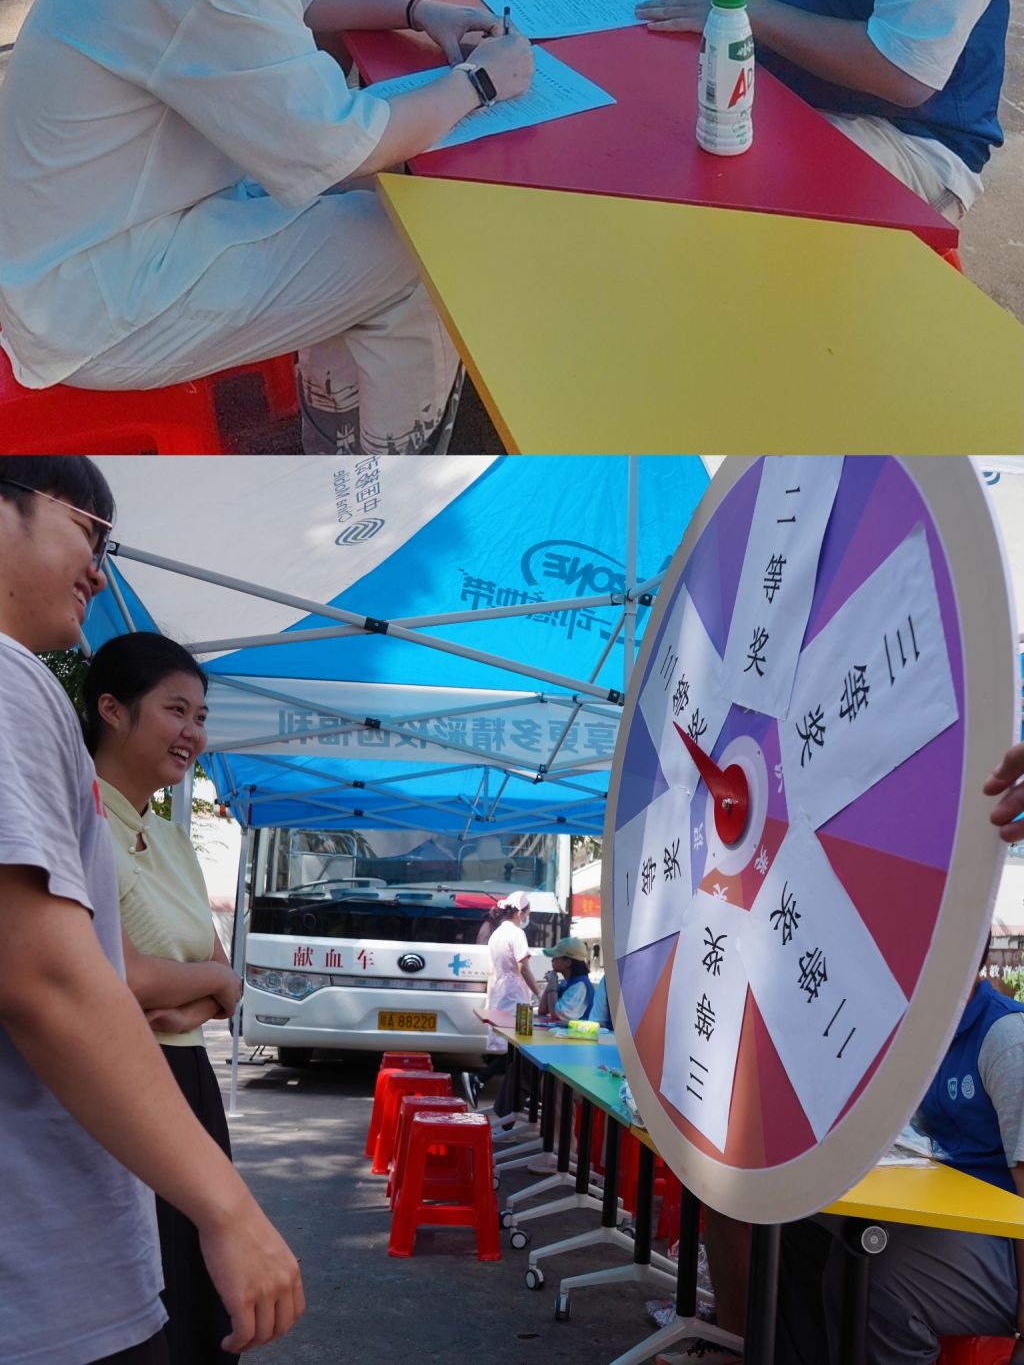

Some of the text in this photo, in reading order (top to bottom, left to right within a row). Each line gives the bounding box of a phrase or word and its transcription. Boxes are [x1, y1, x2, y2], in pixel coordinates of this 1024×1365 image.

[744, 486, 801, 678] 二等奖
[796, 614, 921, 768] 三等奖
[626, 837, 681, 907] 一等奖
[293, 946, 376, 971] 献血车
[685, 926, 729, 1102] 三等奖
[769, 880, 857, 1059] 二等奖
